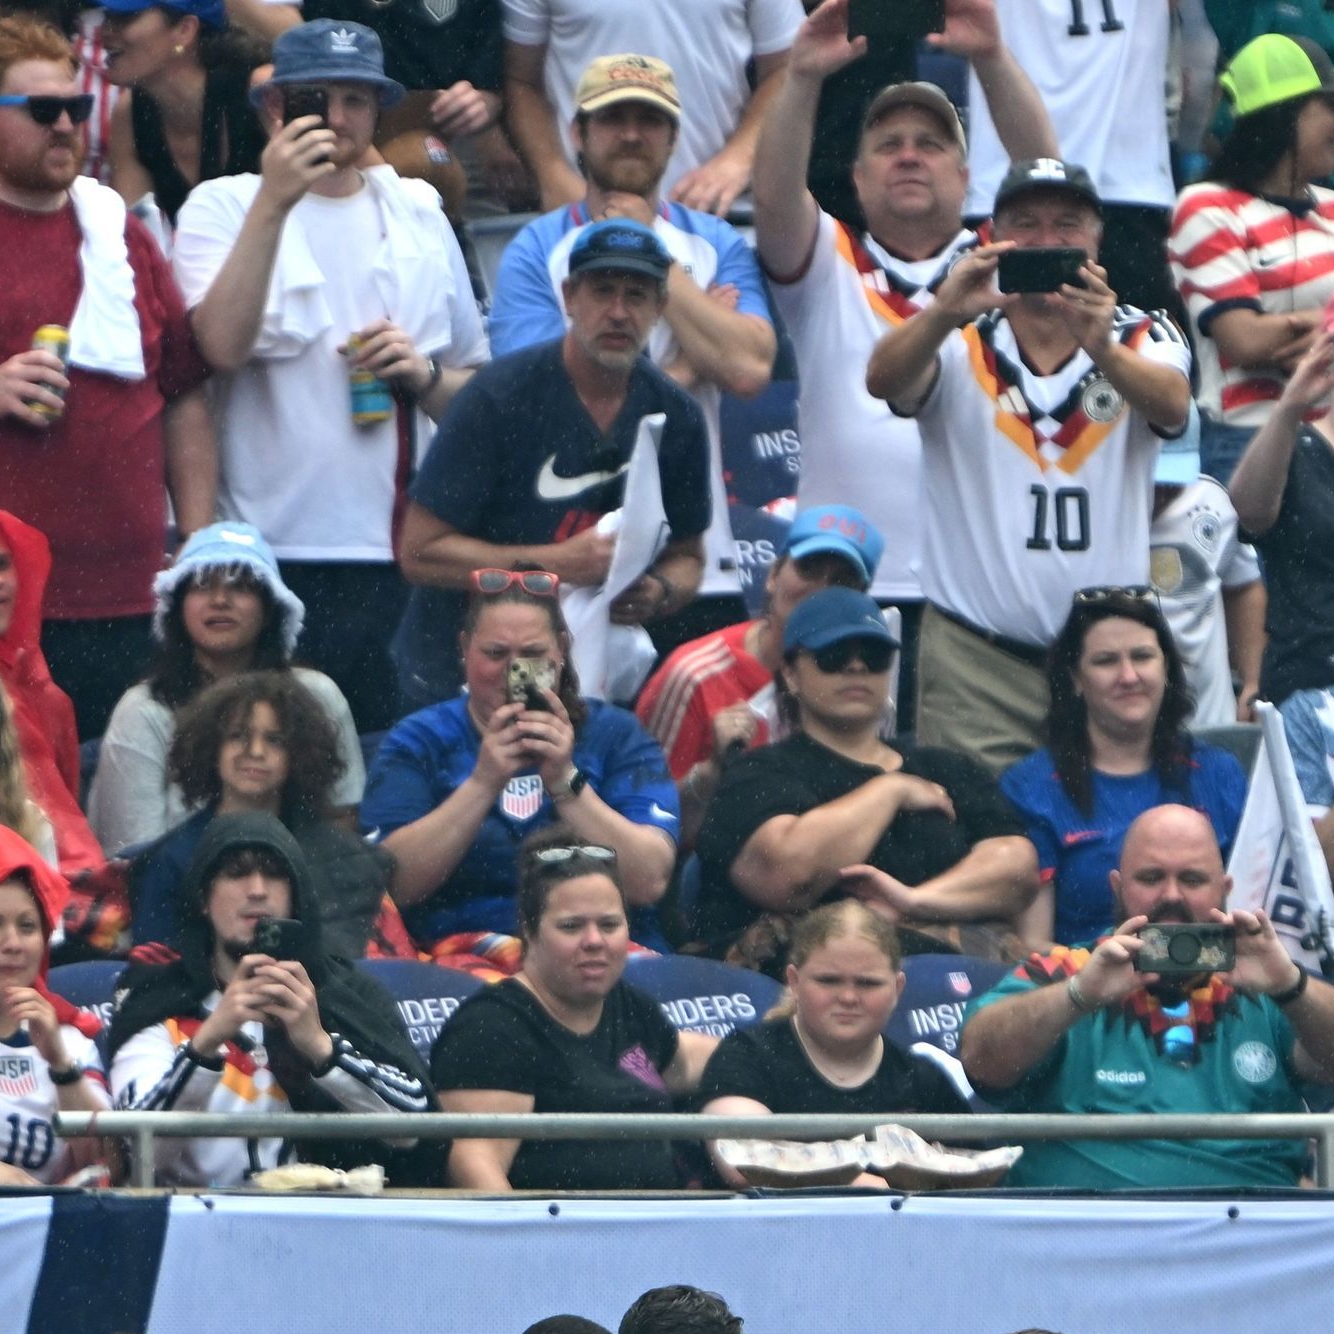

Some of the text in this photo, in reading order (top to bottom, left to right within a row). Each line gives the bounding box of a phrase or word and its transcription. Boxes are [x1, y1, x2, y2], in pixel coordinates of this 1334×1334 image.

[1026, 483, 1091, 551] 10
[1095, 1068, 1147, 1084] adidas
[2, 1111, 54, 1170] 10
